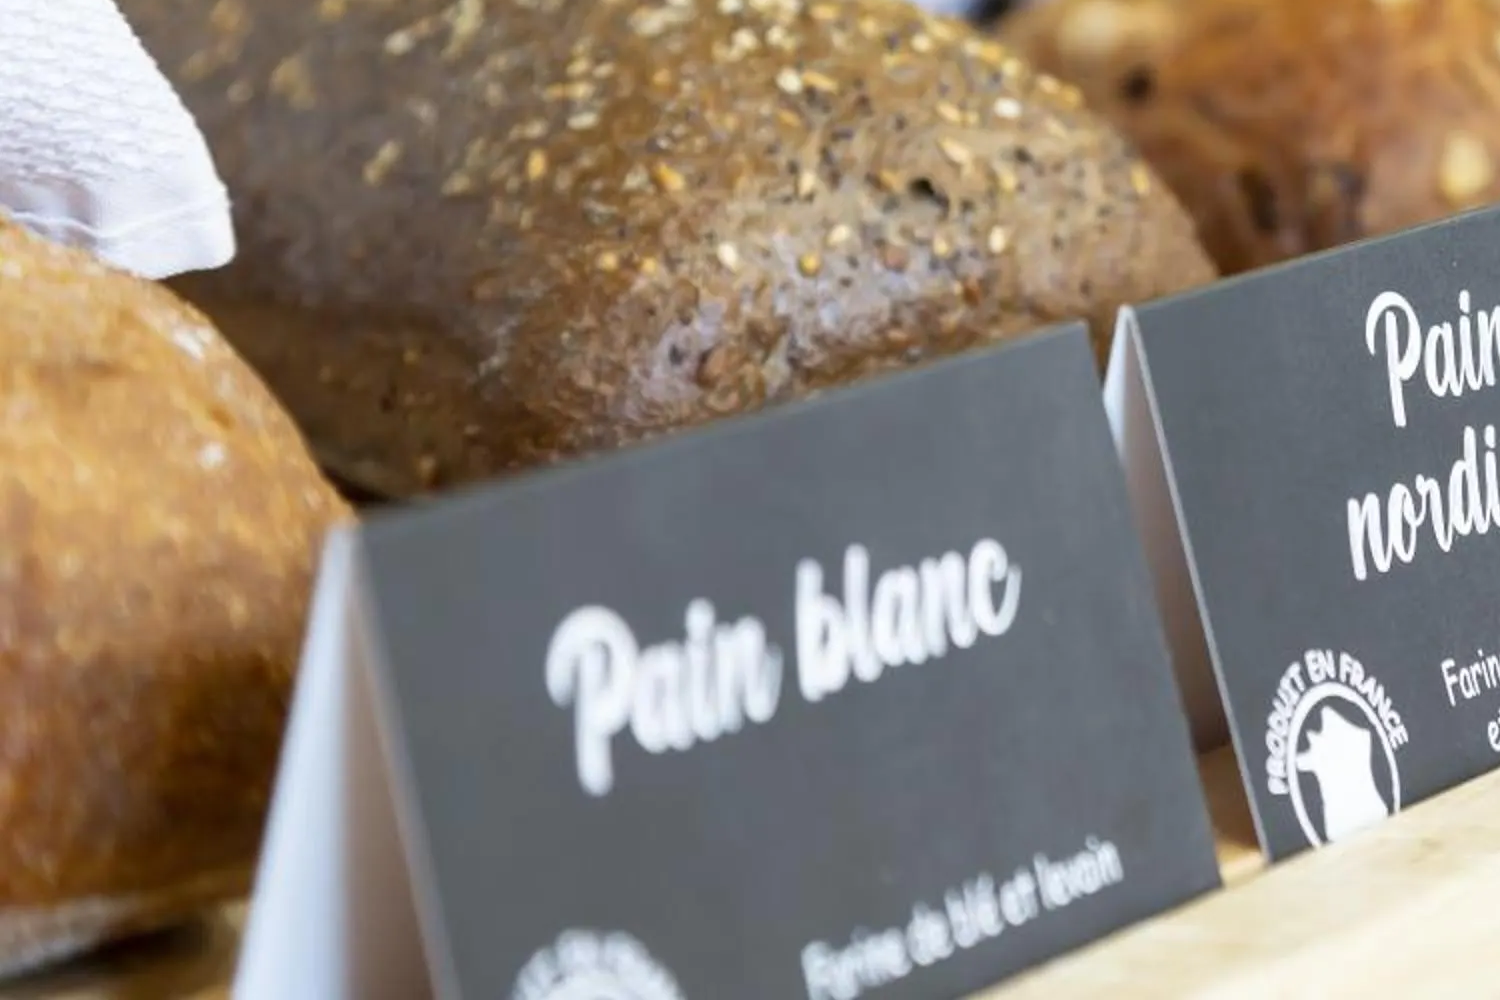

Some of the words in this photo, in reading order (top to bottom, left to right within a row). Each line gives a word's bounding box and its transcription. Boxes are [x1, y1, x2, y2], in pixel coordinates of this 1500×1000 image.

[545, 598, 783, 797] Pain
[796, 538, 1022, 702] blanc
[1266, 662, 1305, 794] PRODUIT
[1304, 649, 1336, 684] EN
[1339, 651, 1409, 750] FRANCE
[1000, 864, 1039, 927] et
[1033, 834, 1124, 910] levain
